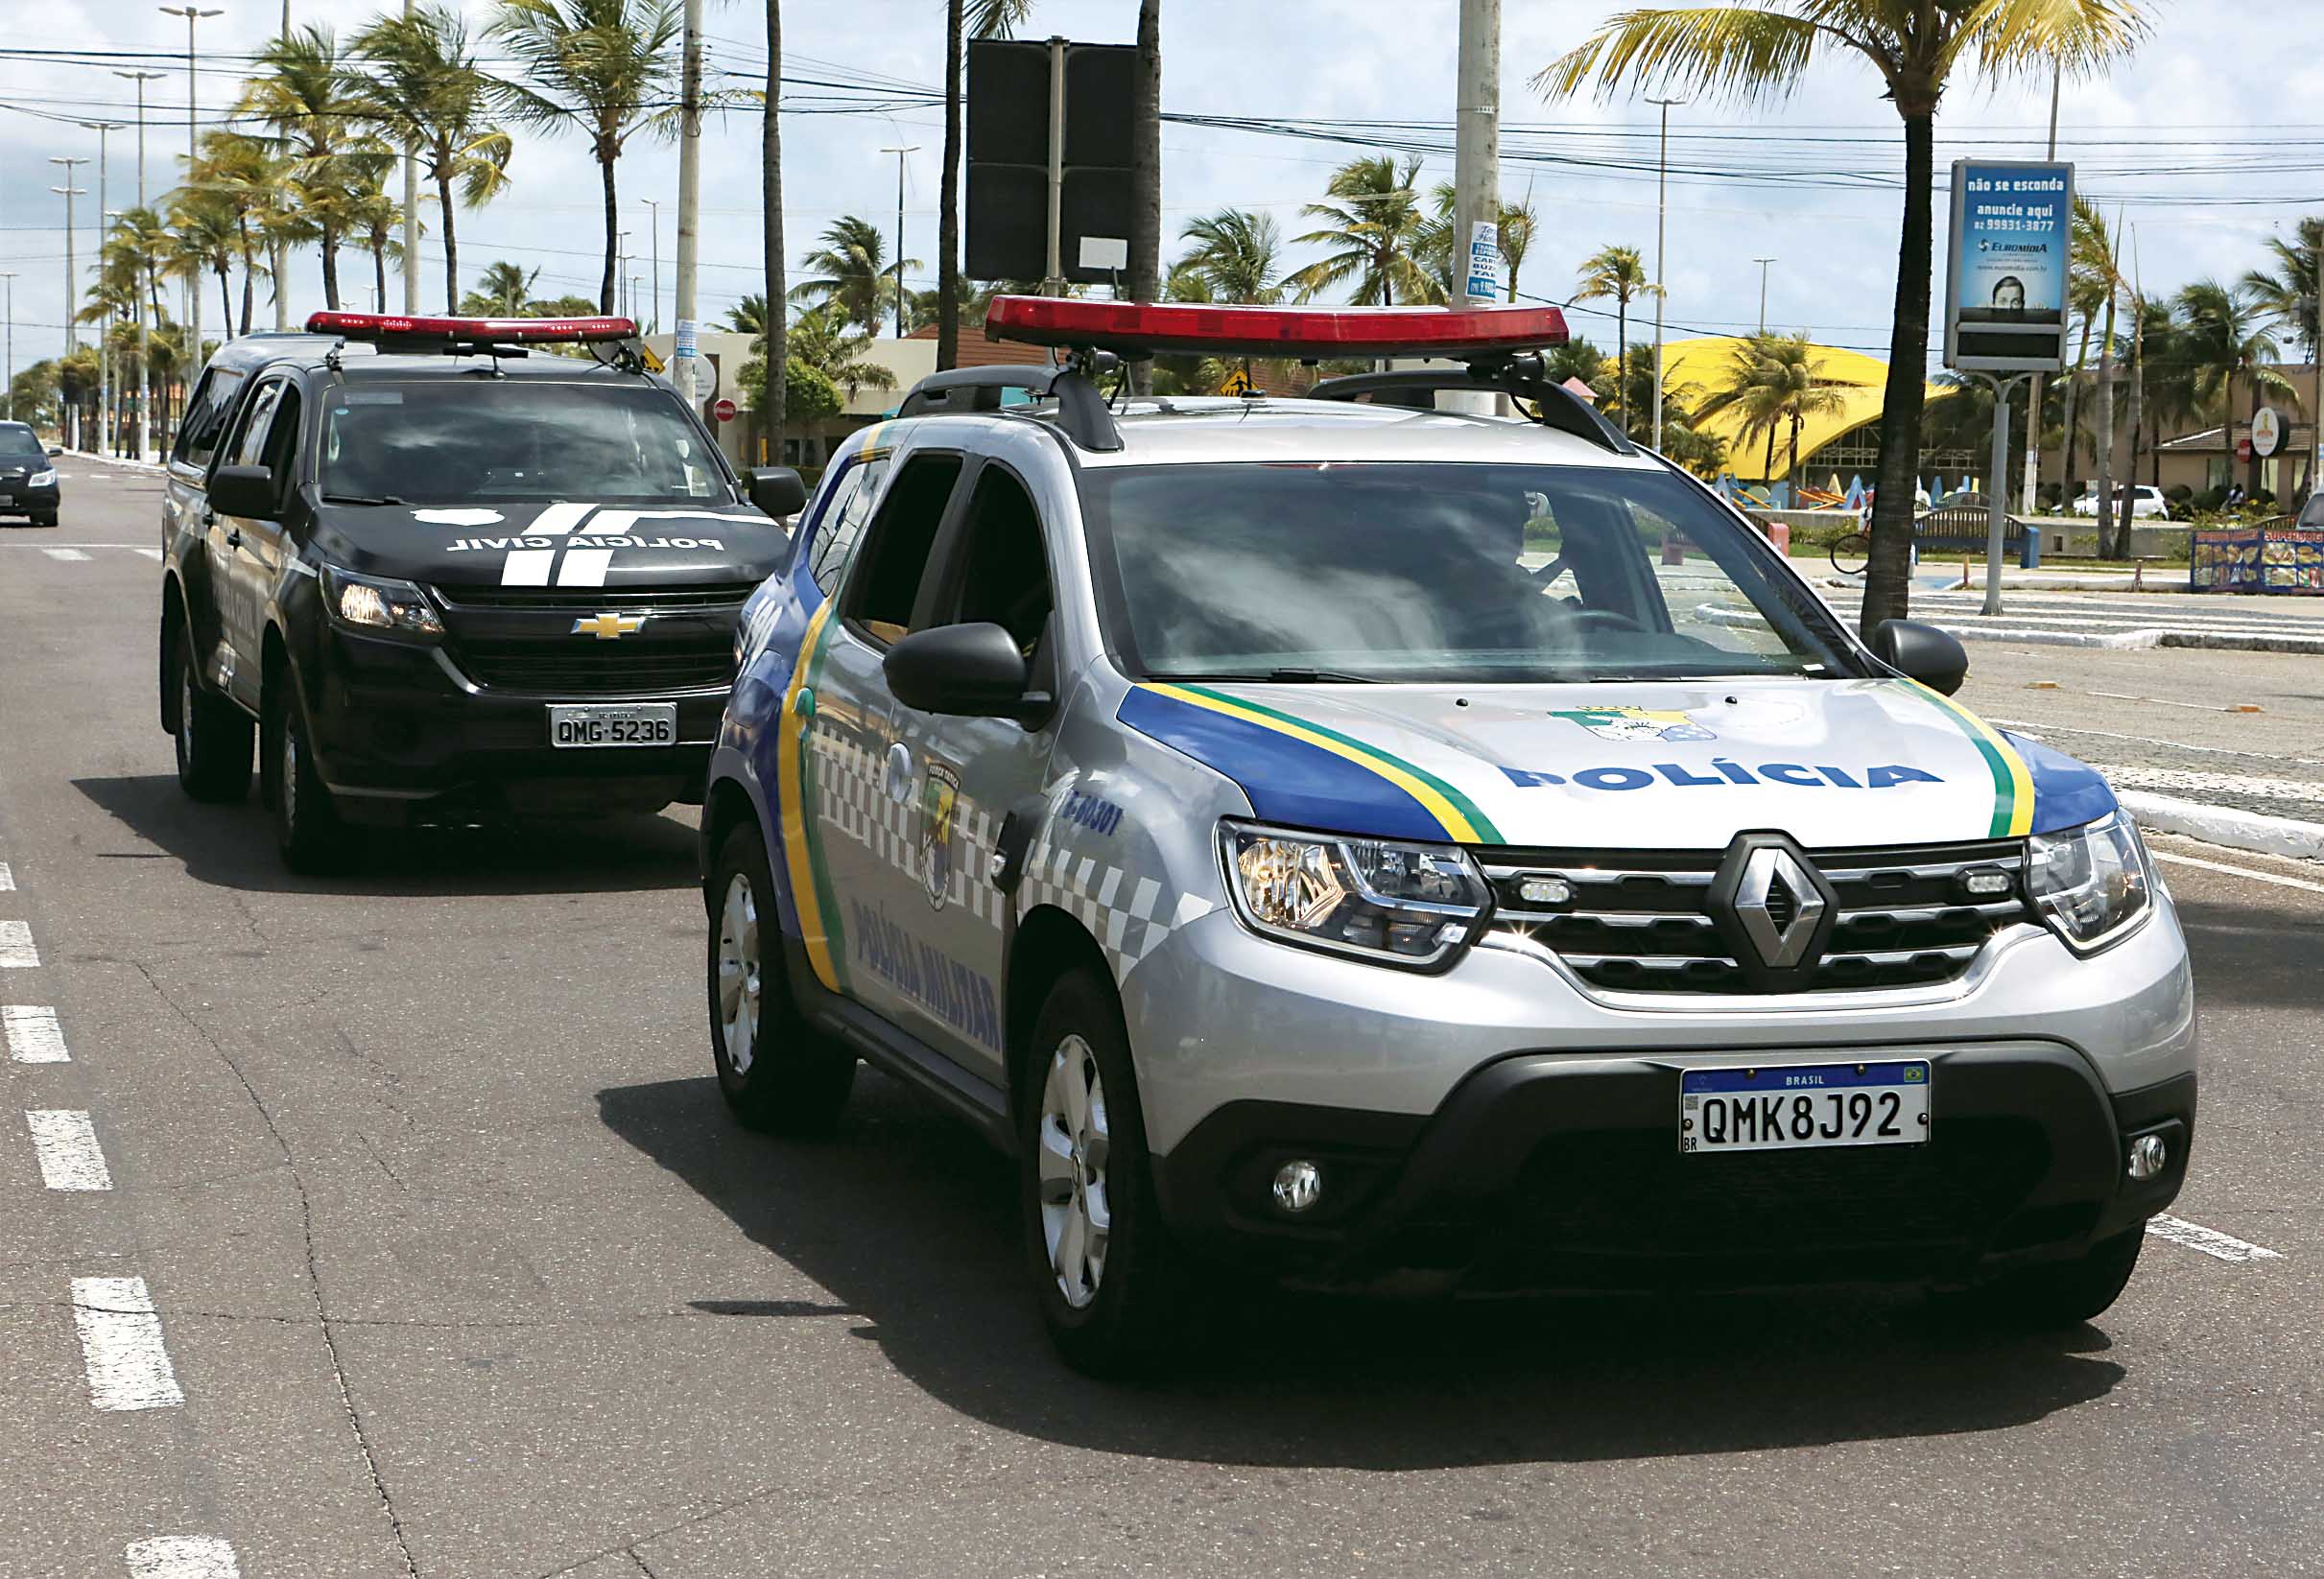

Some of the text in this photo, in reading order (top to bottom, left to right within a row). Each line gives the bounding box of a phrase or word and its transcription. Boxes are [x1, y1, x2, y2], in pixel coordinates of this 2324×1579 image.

[1967, 177, 2064, 191] não se esconda
[1977, 203, 2052, 220] anuncie aqui
[1496, 757, 1946, 790] POLÍCIA
[1785, 1075, 1824, 1086] BRASIL
[1702, 1091, 1902, 1144] QMK8J92
[1683, 1136, 1697, 1151] BR
